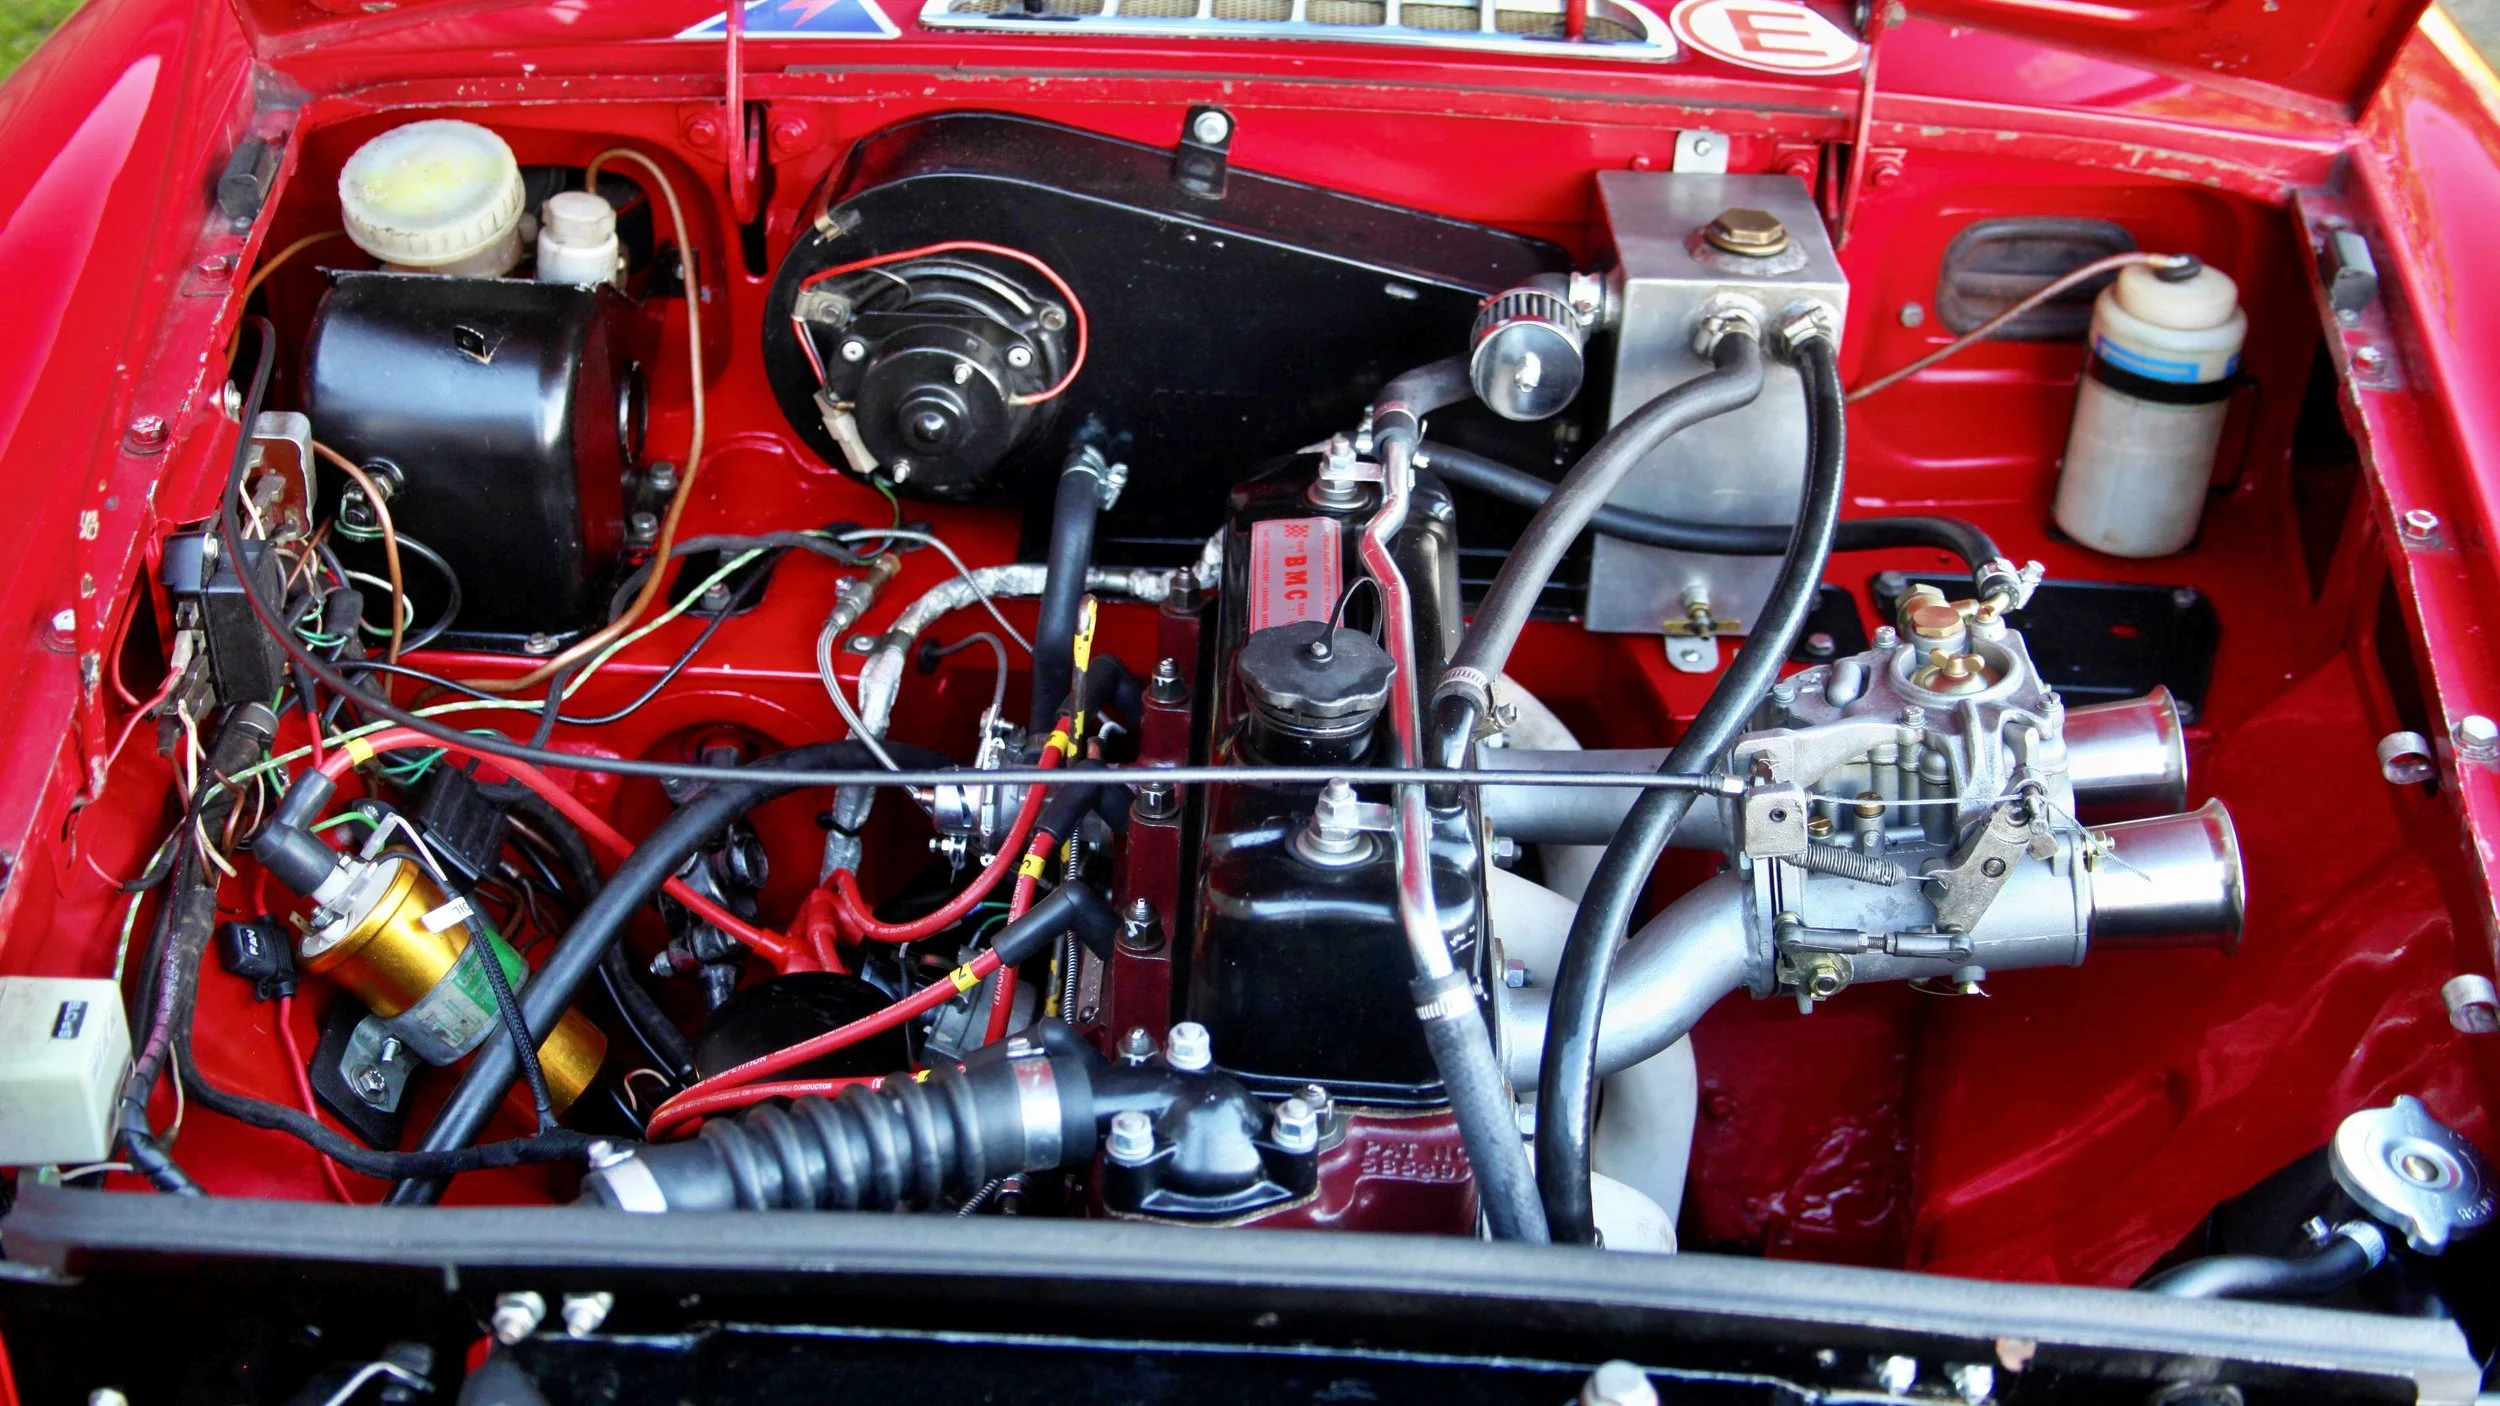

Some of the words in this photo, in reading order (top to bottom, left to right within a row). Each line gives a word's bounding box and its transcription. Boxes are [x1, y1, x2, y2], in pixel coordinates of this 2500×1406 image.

[1725, 8, 1829, 58] E
[1284, 555, 1308, 601] BMC
[246, 929, 259, 956] FAN
[792, 1082, 833, 1092] CONDUCTOR
